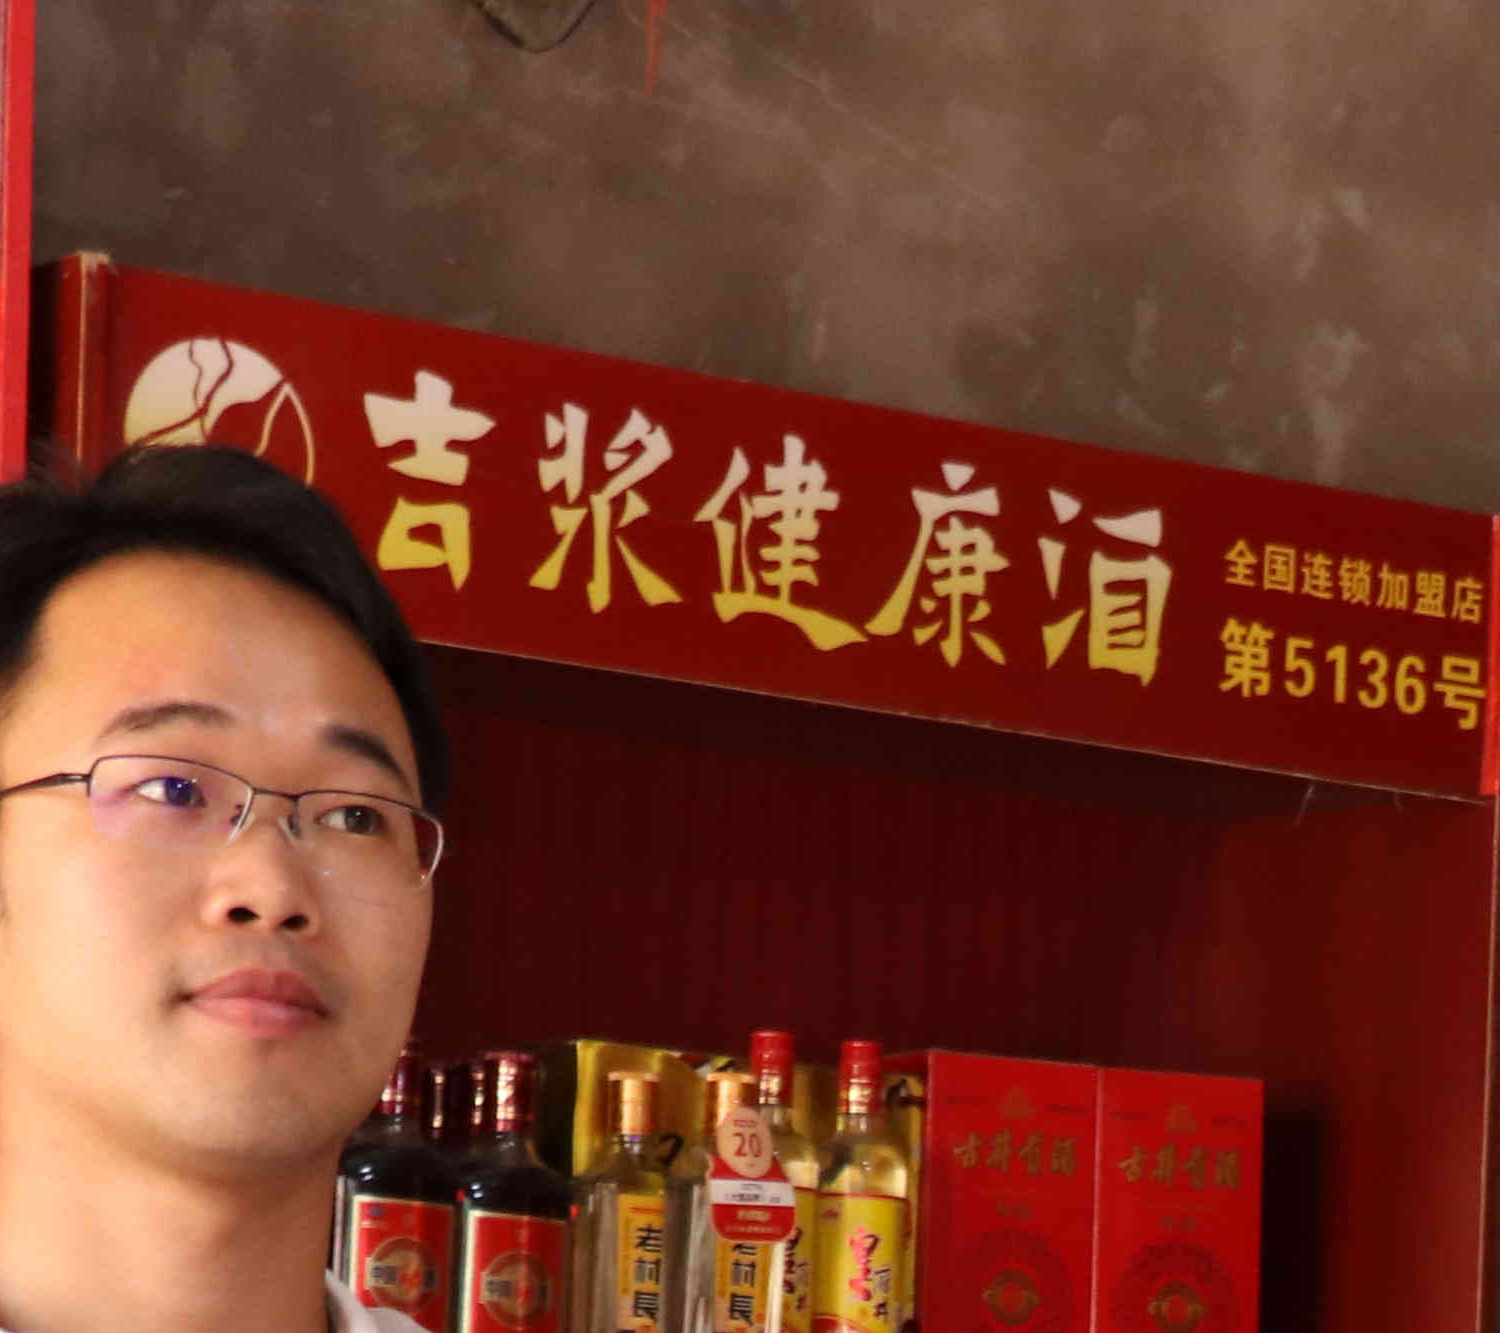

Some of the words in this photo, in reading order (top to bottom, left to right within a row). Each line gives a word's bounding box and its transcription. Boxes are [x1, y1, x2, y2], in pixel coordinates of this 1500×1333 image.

[362, 368, 1174, 688] 吉浆健康酒
[1220, 535, 1487, 628] 全国连锁加盟店
[1217, 616, 1490, 734] 第5136号
[731, 1131, 766, 1161] 20
